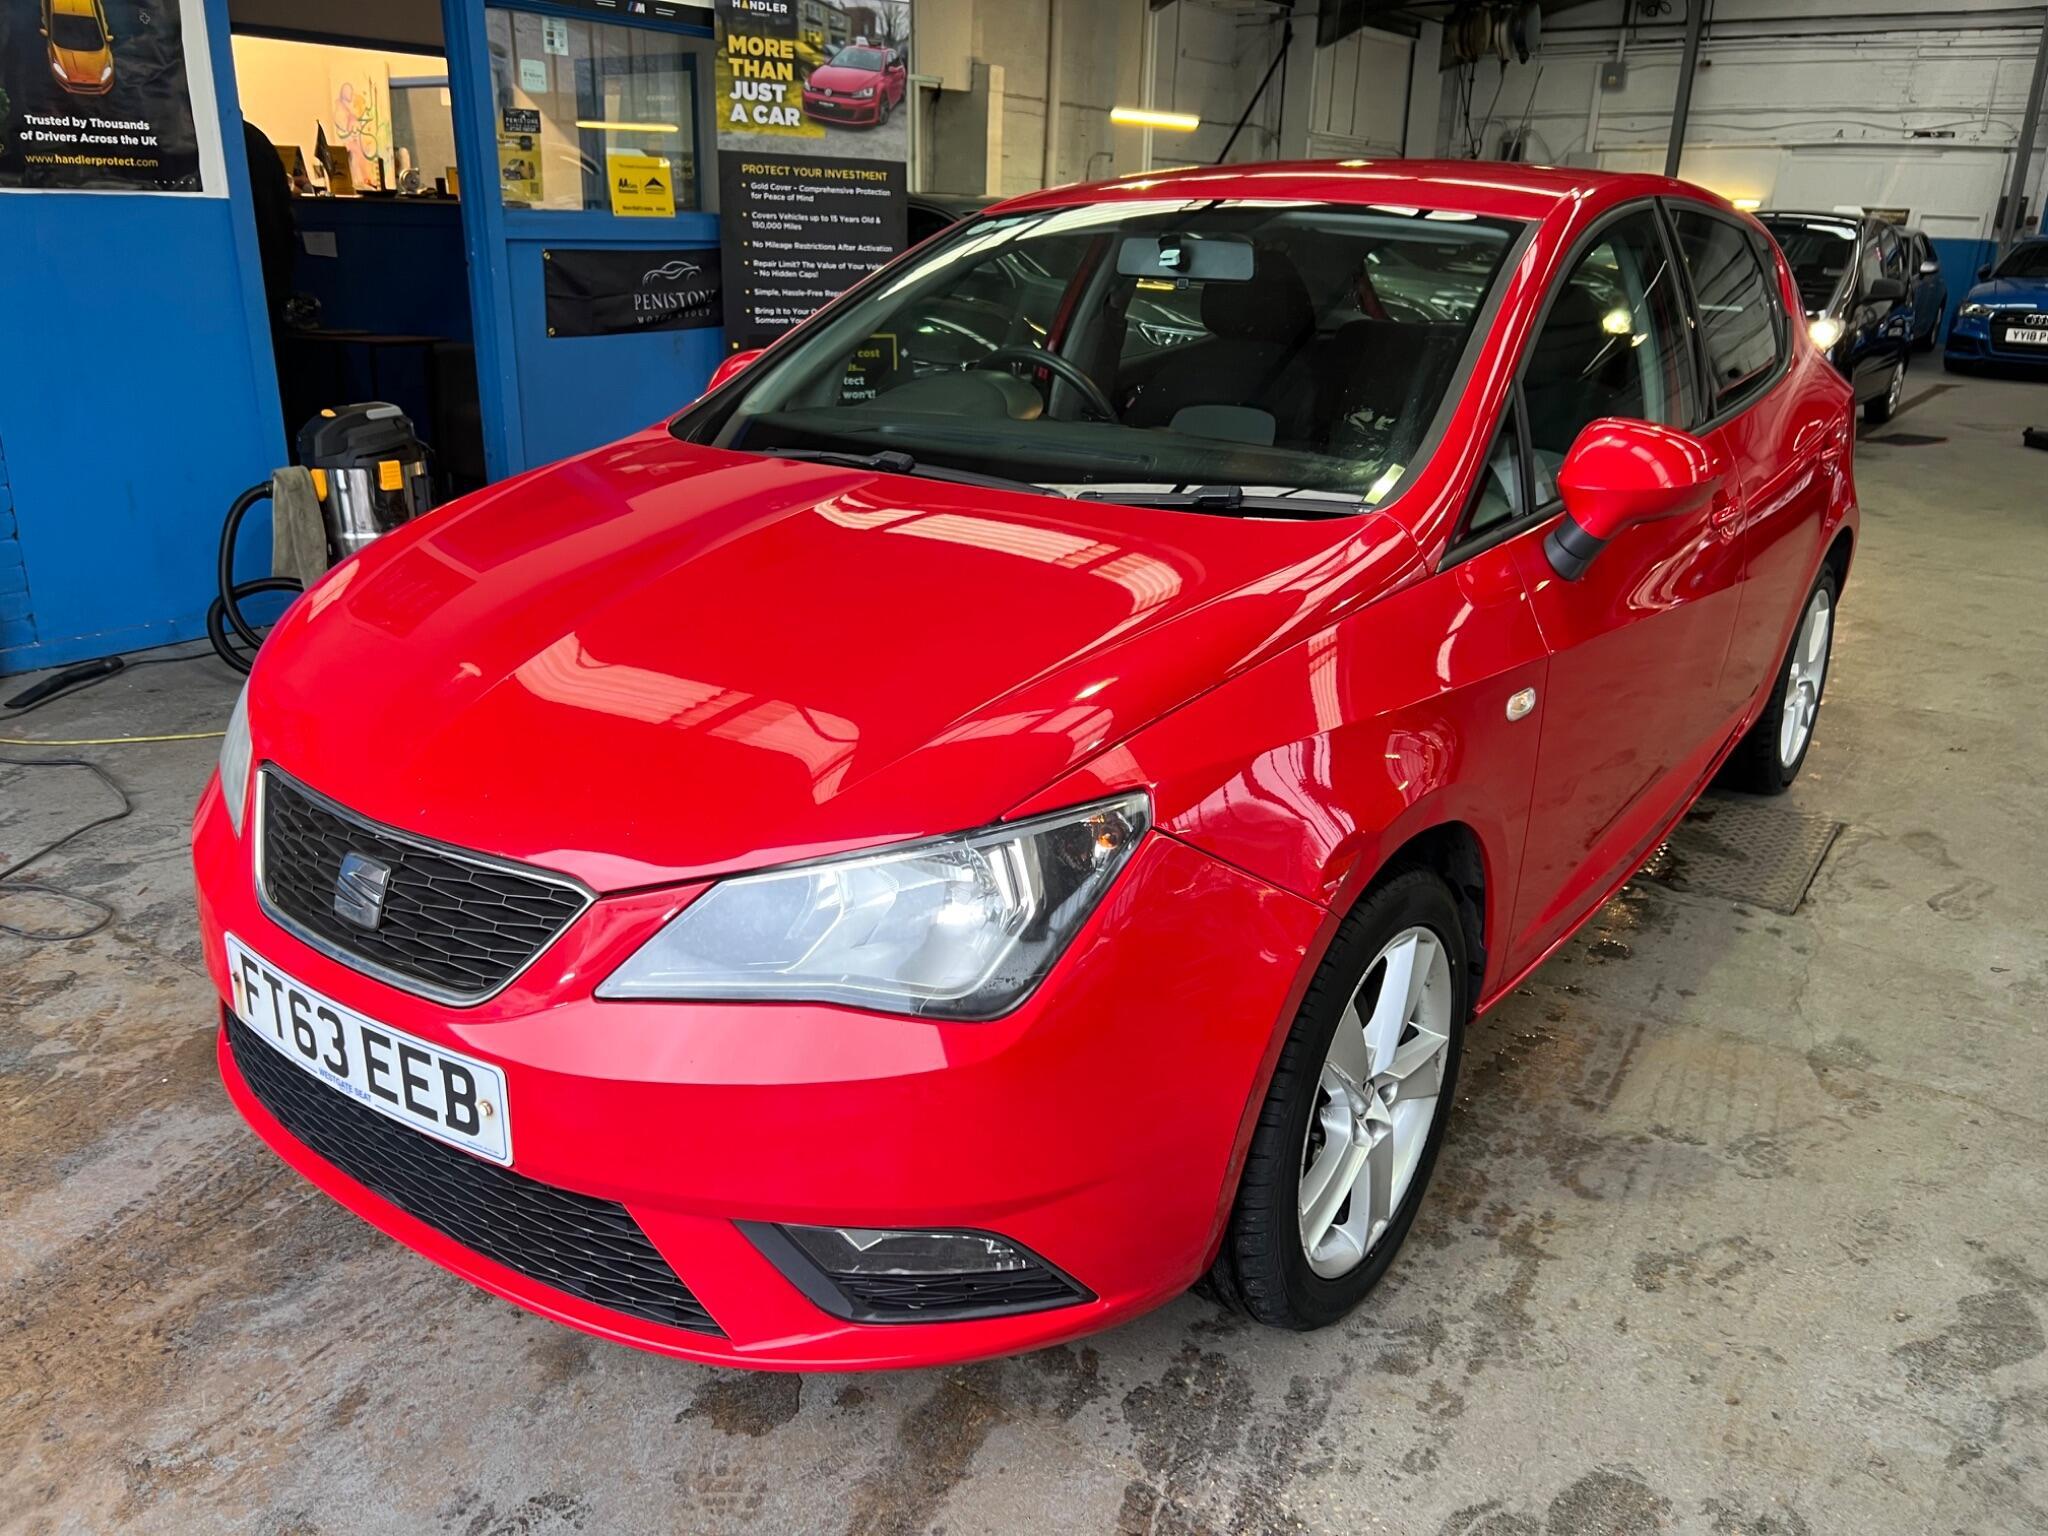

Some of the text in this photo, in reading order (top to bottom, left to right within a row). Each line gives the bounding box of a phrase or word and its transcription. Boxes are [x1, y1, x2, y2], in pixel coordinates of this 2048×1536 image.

[732, 0, 788, 14] HANDLER
[728, 34, 795, 59] MORE
[728, 57, 793, 81] THAN
[729, 80, 787, 103] JUST
[730, 103, 800, 127] A CAR
[24, 114, 150, 131] Trusted by Thousands
[20, 131, 158, 146] of Drivers Across the UK
[25, 153, 159, 168] www.handlerprotect.com
[741, 164, 888, 182] PROTECT YOUR INVESTMENT
[751, 182, 768, 190] Gold
[770, 183, 792, 191] Cover
[799, 185, 855, 194] Comprehensive
[855, 187, 892, 196] Protection
[751, 191, 815, 202] for Peace of Mind
[751, 211, 777, 220] Covers
[778, 212, 808, 221] Vehicles
[830, 214, 839, 223] 15
[840, 215, 860, 224] Years
[861, 216, 875, 224] Old
[876, 216, 882, 224] &
[752, 221, 802, 231] 150,000 Miles
[752, 240, 893, 252] No Mileage Restrictions After Activation
[753, 260, 777, 268] Repair
[778, 260, 800, 268] Limit?
[801, 261, 815, 269] The
[771, 270, 797, 278] Hidden
[754, 288, 781, 297] Simple,
[782, 289, 823, 297] Hassle-Free
[754, 307, 774, 316] Bring
[2013, 330, 2037, 341] YY18
[857, 348, 880, 358] cost
[843, 376, 865, 386] tect
[842, 389, 876, 399] won't!
[240, 952, 480, 1137] FT63 EEB
[318, 1067, 372, 1103] WESTGATE SEAT
